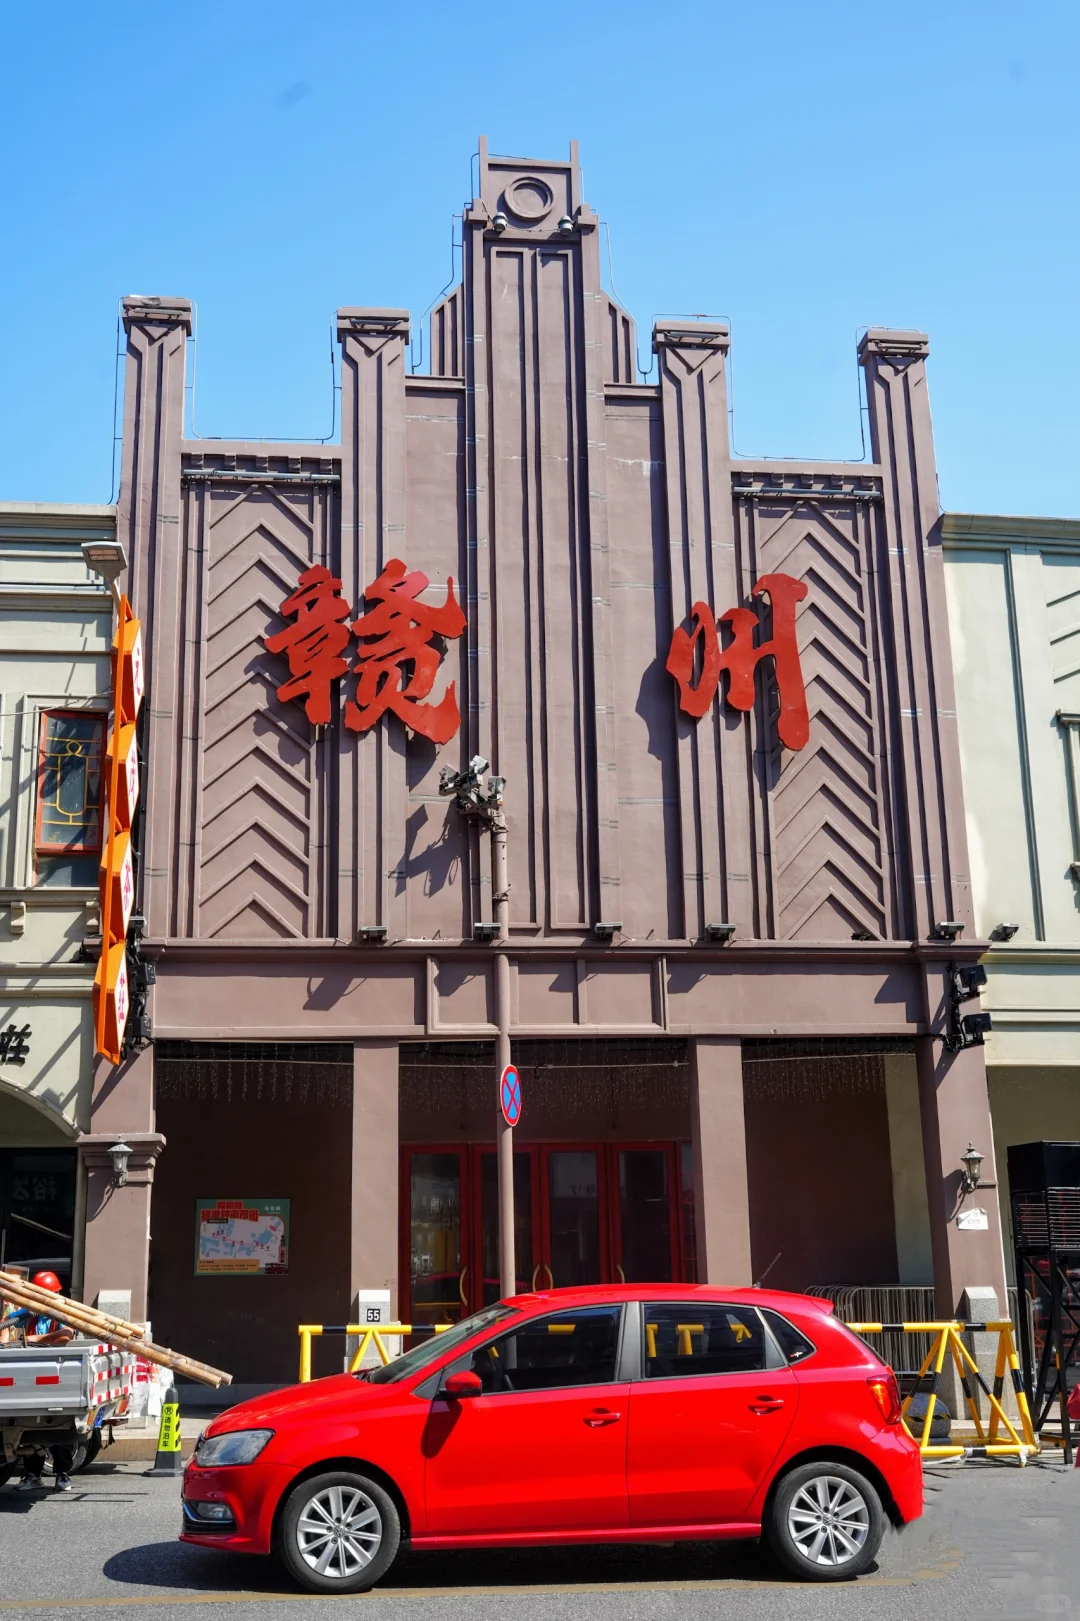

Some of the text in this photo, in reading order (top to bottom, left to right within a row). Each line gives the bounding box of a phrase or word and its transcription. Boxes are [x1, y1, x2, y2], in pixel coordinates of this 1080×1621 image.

[265, 558, 811, 751] 赣州
[367, 1310, 380, 1321] 55
[162, 1416, 172, 1448] 请勿泊车
